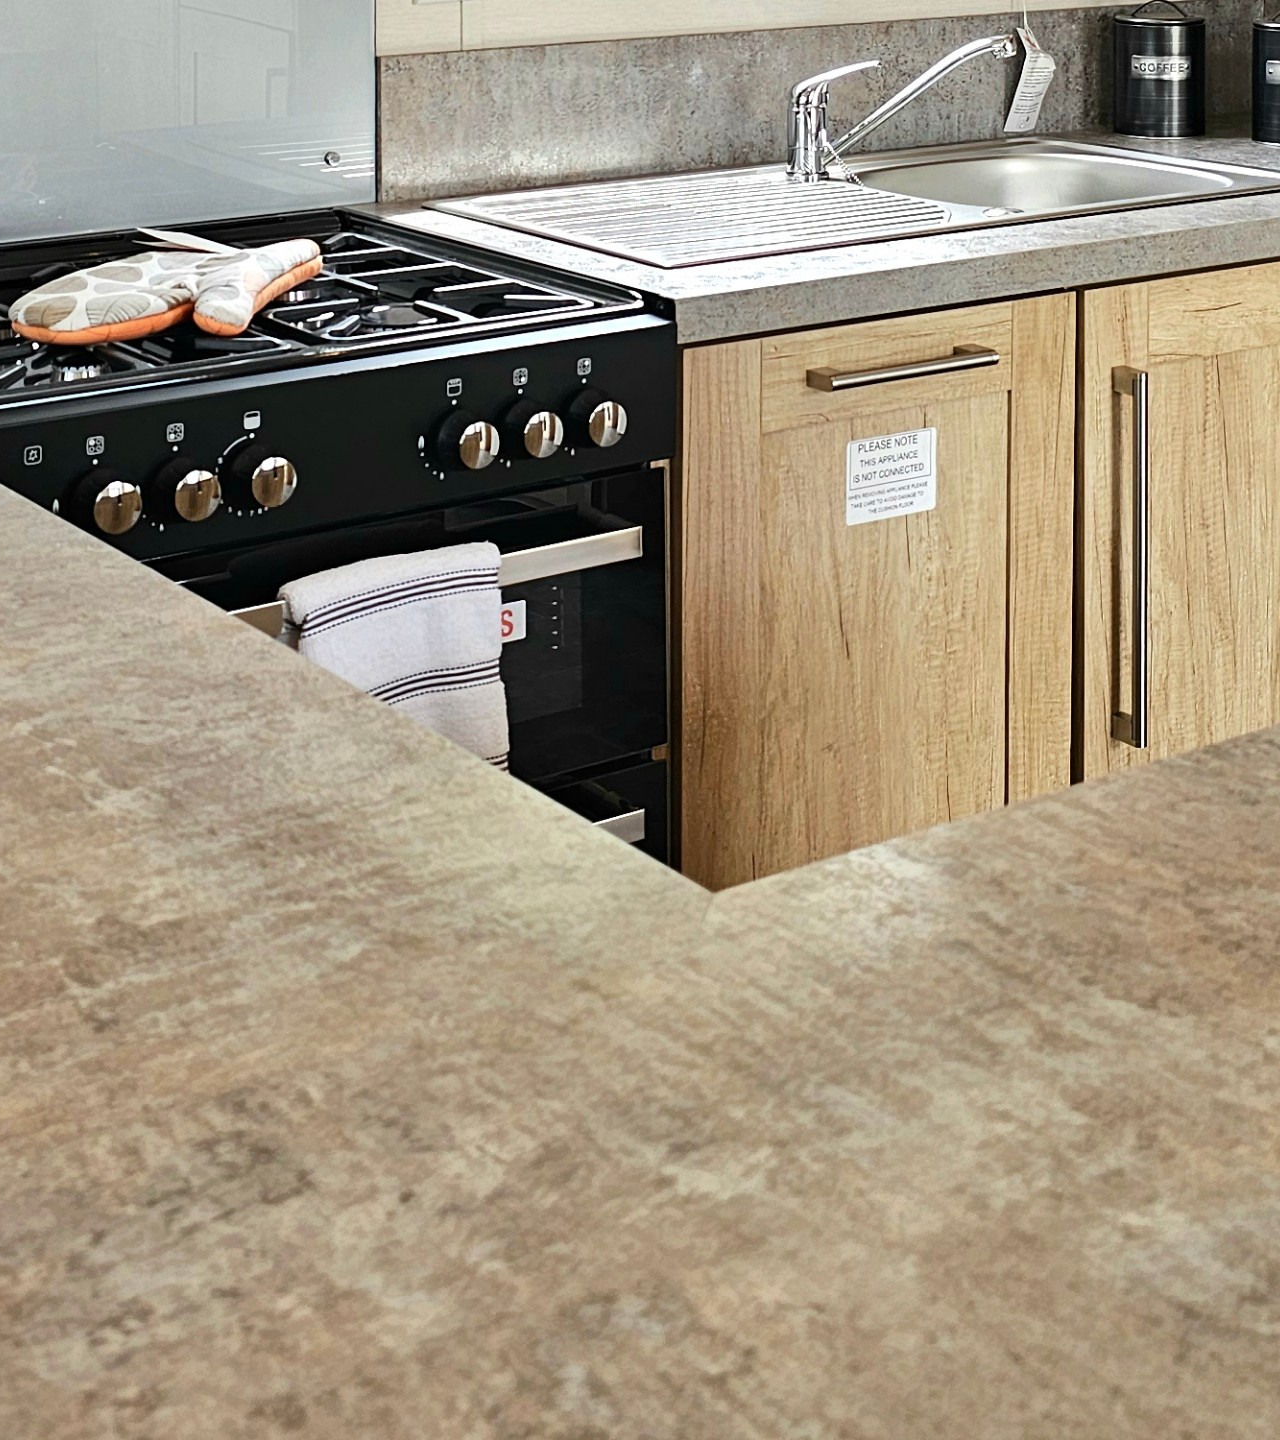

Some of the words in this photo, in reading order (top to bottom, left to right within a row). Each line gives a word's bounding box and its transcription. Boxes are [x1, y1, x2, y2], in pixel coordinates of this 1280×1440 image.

[1140, 63, 1185, 72] COFFEE
[858, 438, 892, 454] PLEASE
[894, 434, 918, 448] NOTE
[859, 457, 876, 468] THIS
[878, 449, 918, 465] APPLIANCE
[852, 474, 860, 483] IS
[862, 471, 877, 481] NOT
[879, 462, 925, 479] CONNECTED
